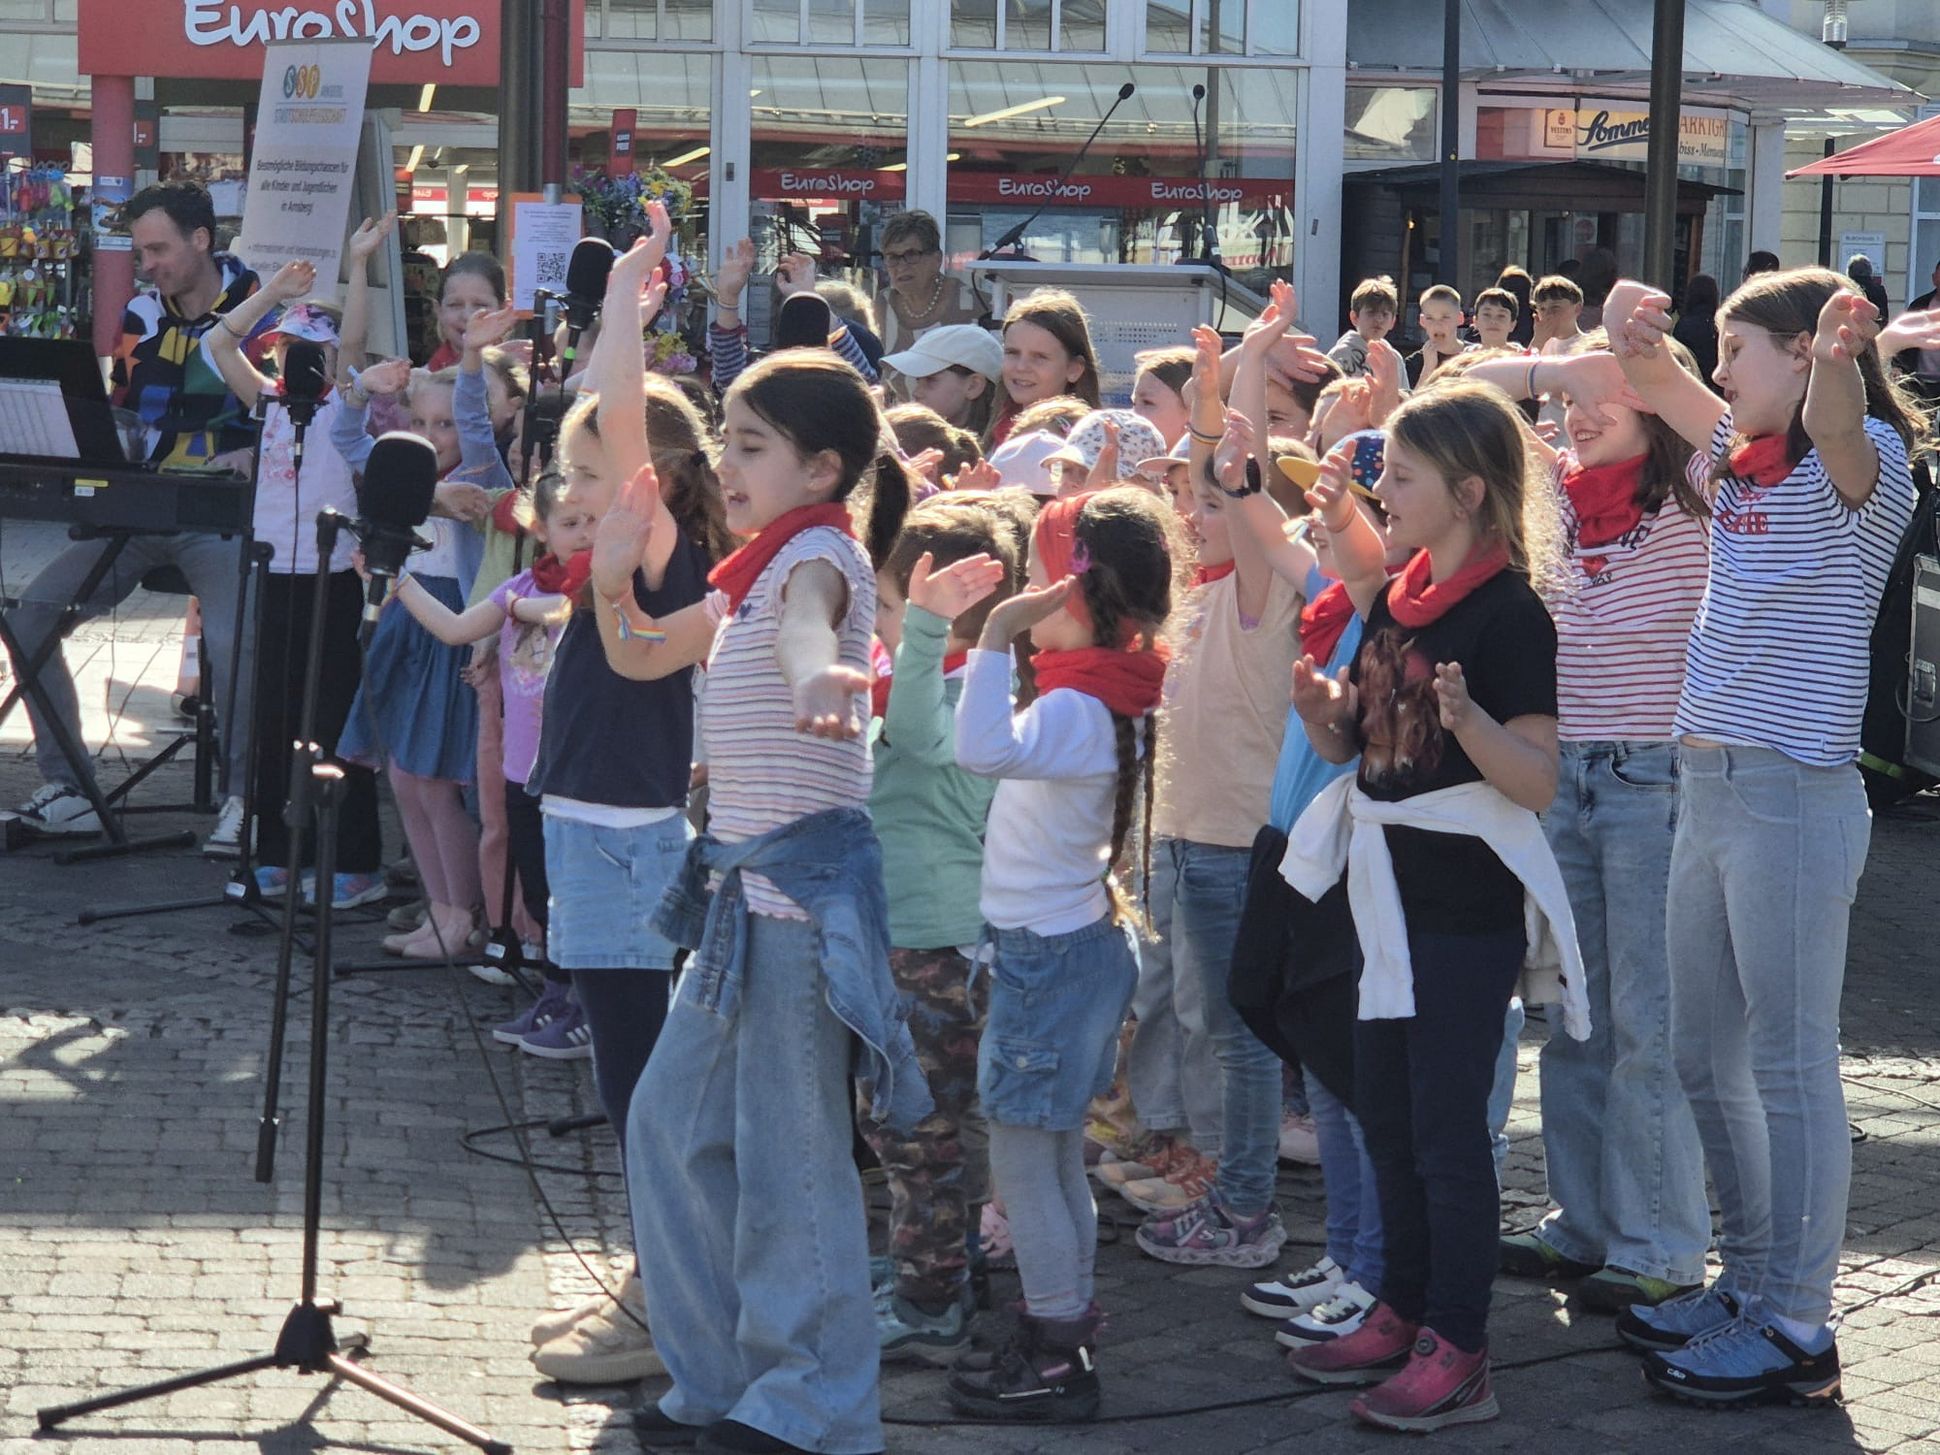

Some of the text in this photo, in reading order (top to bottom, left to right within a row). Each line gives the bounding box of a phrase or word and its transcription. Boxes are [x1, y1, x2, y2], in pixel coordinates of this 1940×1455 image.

[184, 0, 481, 66] EuroShop
[780, 173, 875, 196] EuroShop
[998, 178, 1092, 201] EuroShop
[1150, 182, 1243, 202] EuroShop
